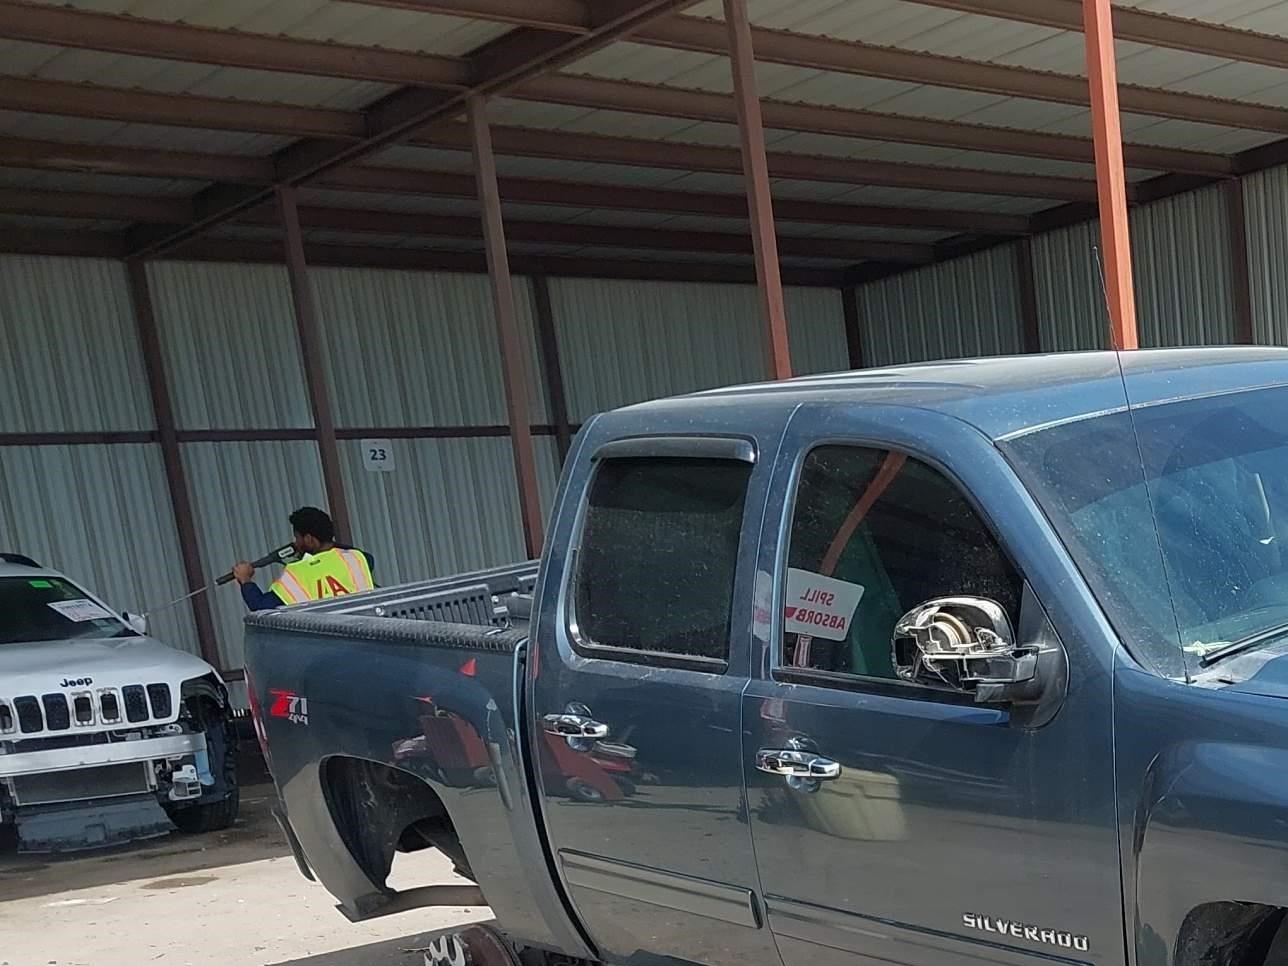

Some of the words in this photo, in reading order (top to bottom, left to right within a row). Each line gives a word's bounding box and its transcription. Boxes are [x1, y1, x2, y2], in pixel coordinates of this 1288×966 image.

[369, 448, 387, 461] 23
[60, 677, 93, 688] Jeep
[270, 688, 308, 717] Z71
[962, 912, 1089, 951] SILVERADO
